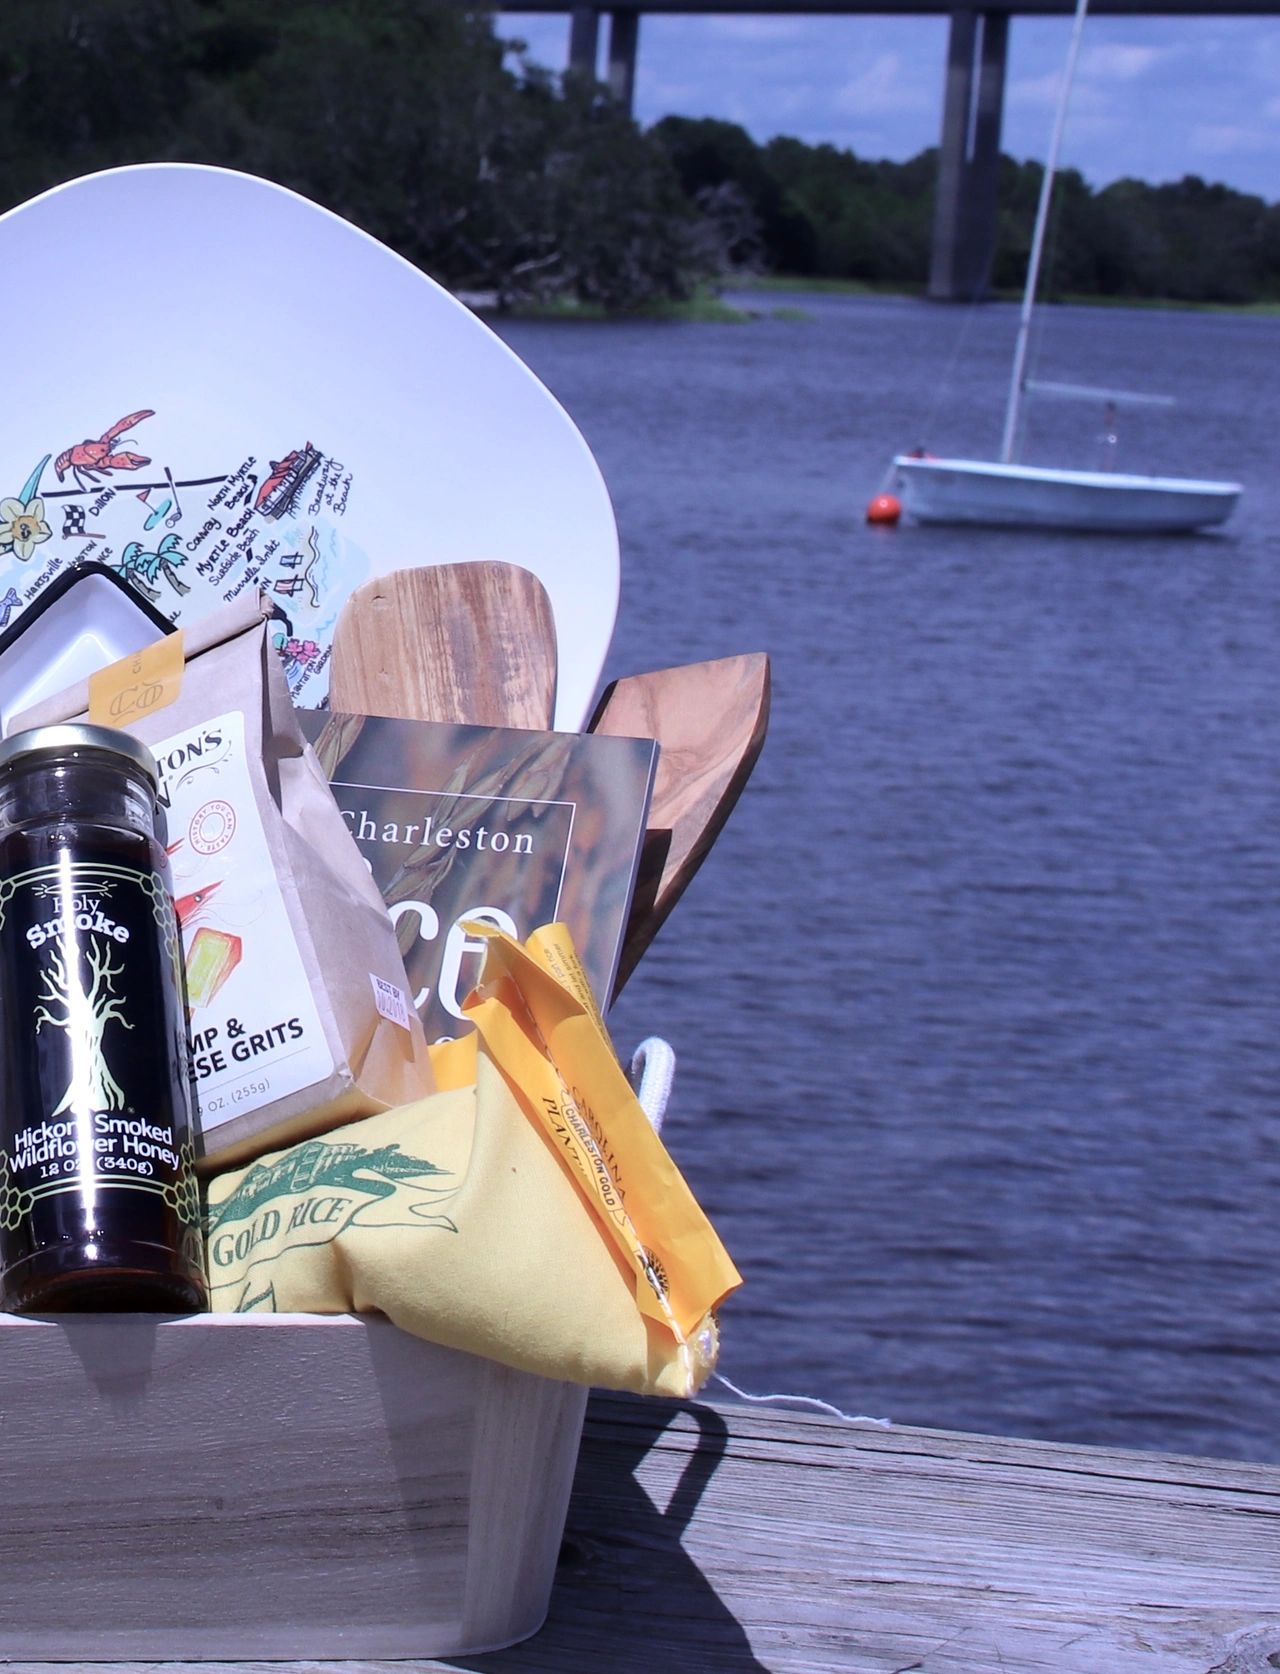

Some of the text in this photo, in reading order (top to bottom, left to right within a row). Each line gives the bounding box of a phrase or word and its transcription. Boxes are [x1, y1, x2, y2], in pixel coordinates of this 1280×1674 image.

[26, 911, 130, 950] Smoke
[226, 1018, 247, 1039] &
[231, 1018, 304, 1062] GRITS
[231, 1078, 271, 1104] (255g)
[14, 1113, 174, 1152] Hickor Smoked
[40, 1162, 61, 1179] 12
[95, 1156, 154, 1176] (340g)
[122, 1134, 180, 1171] Honey
[564, 1107, 616, 1207] CHARLESTON GOLD
[213, 1197, 354, 1267] GOLD RICE
